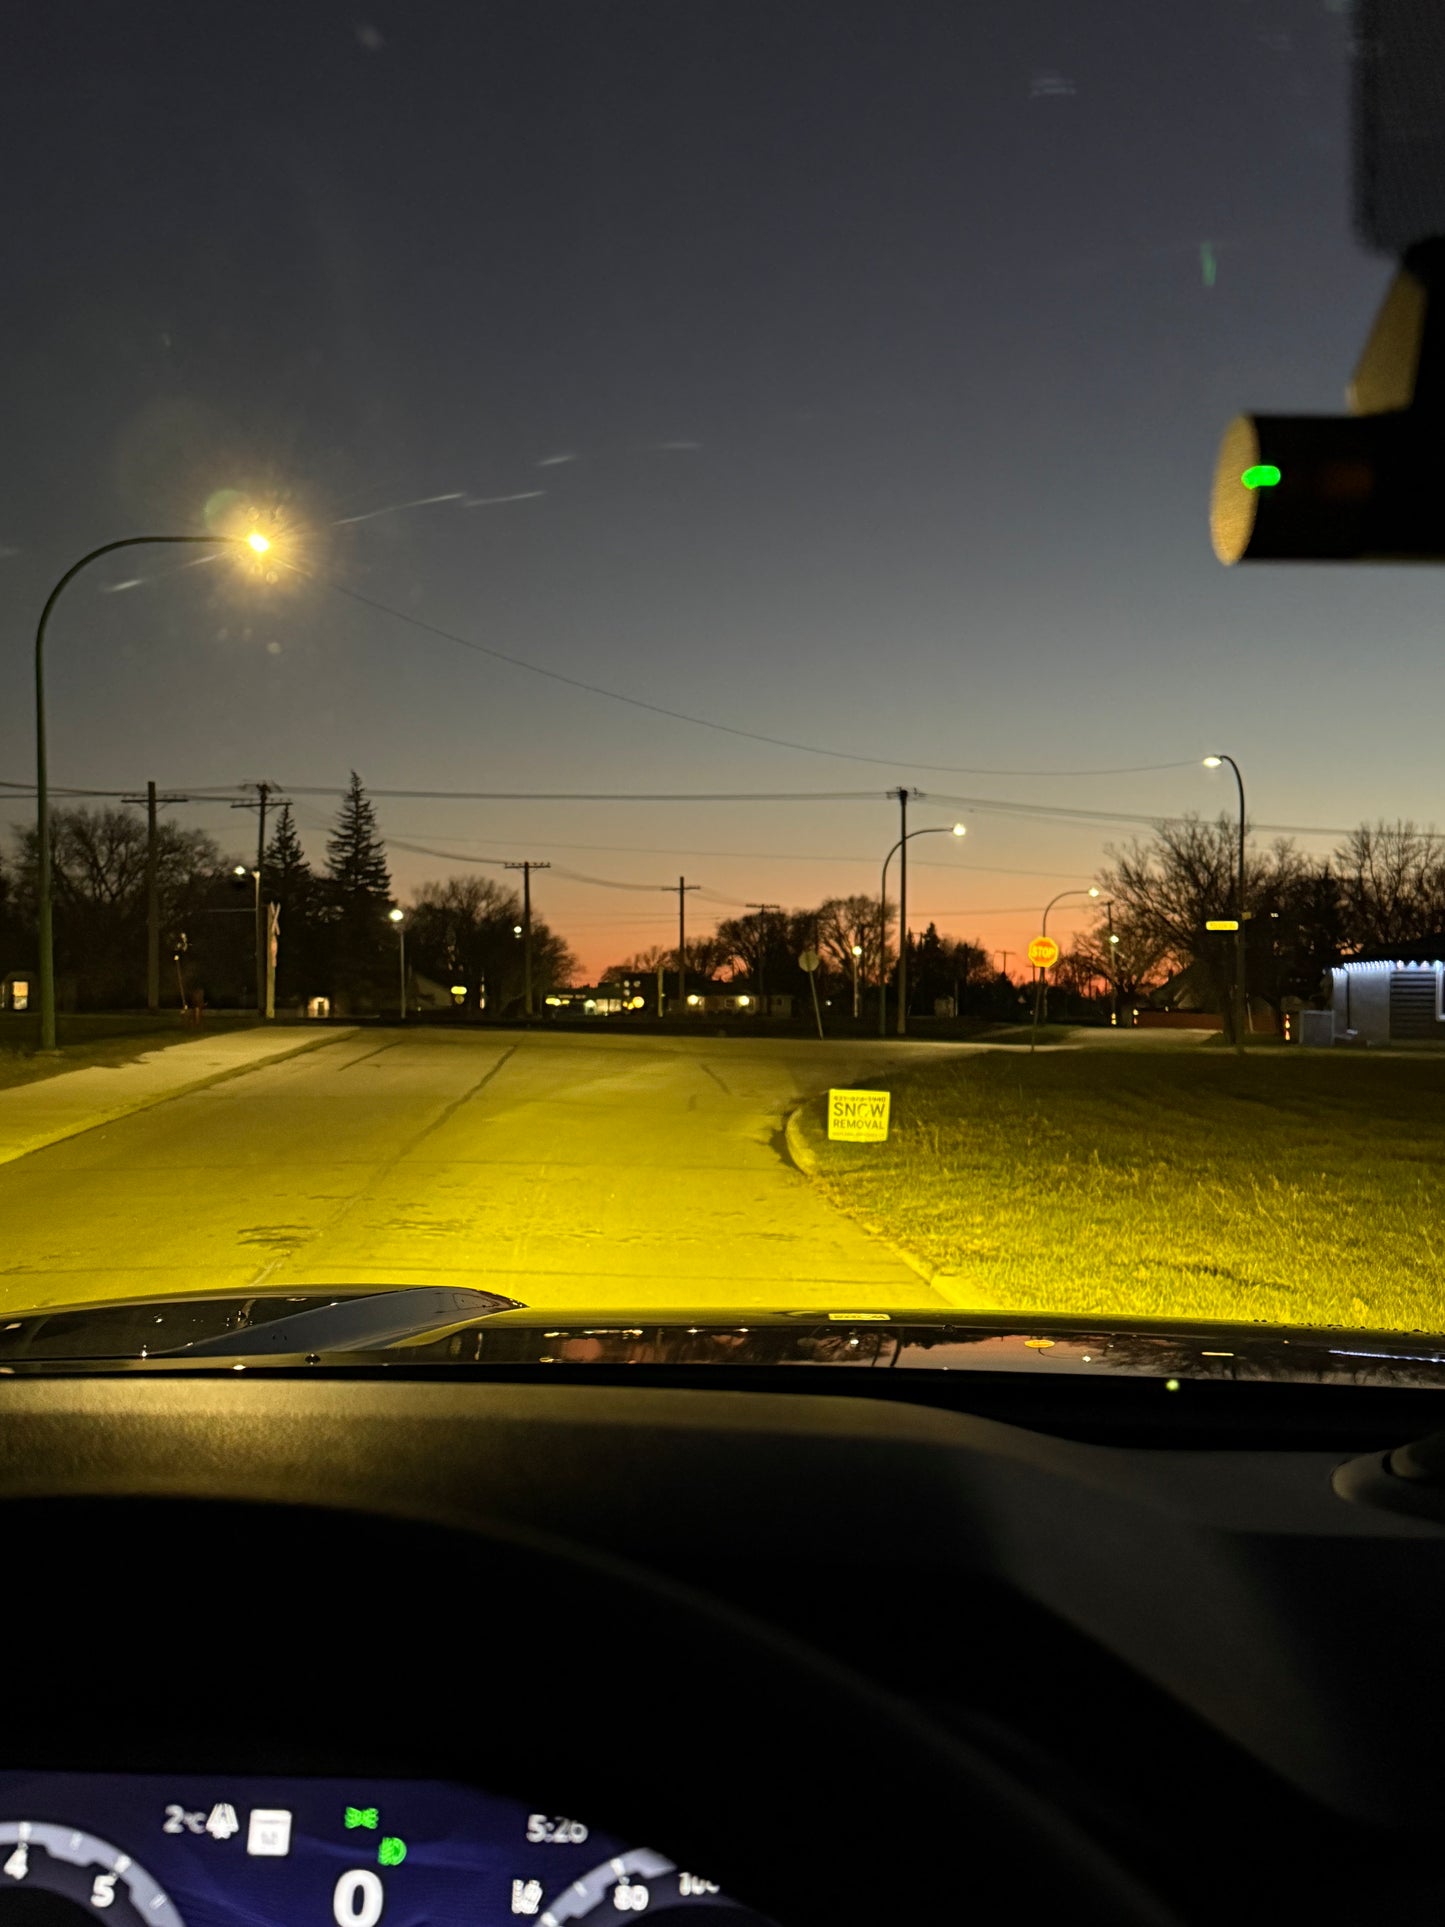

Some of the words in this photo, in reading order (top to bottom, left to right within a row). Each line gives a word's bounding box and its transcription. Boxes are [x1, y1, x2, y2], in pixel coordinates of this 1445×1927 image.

[1031, 946, 1055, 958] STOP
[834, 1102, 885, 1117] SNOW
[833, 1119, 885, 1129] REMOVAL
[90, 1873, 118, 1908] 5
[332, 1869, 384, 1927] 0
